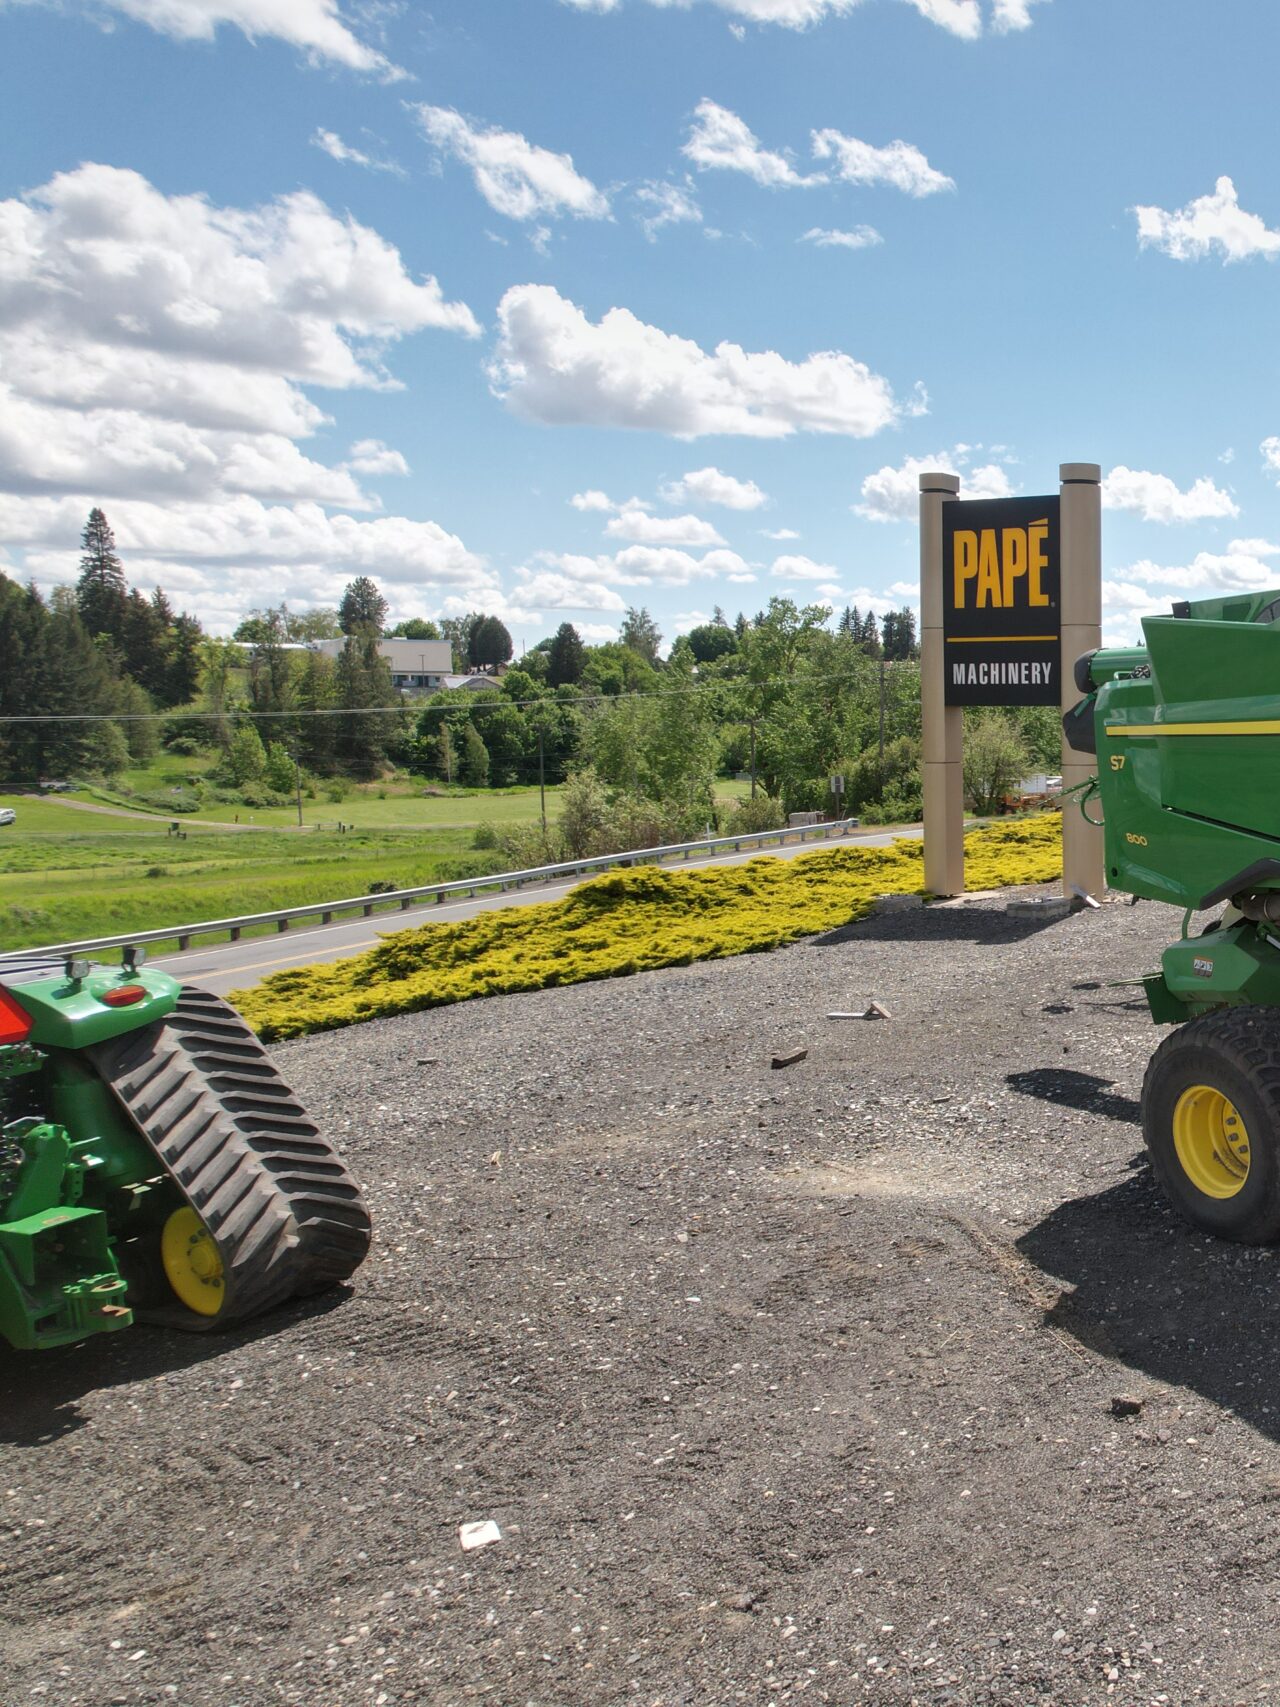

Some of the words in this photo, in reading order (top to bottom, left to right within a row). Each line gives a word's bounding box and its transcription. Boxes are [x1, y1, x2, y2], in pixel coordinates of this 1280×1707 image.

[953, 518, 1049, 609] PAPÉ
[952, 662, 1052, 685] MACHINERY
[1109, 754, 1126, 771] S7
[1125, 832, 1148, 846] 800
